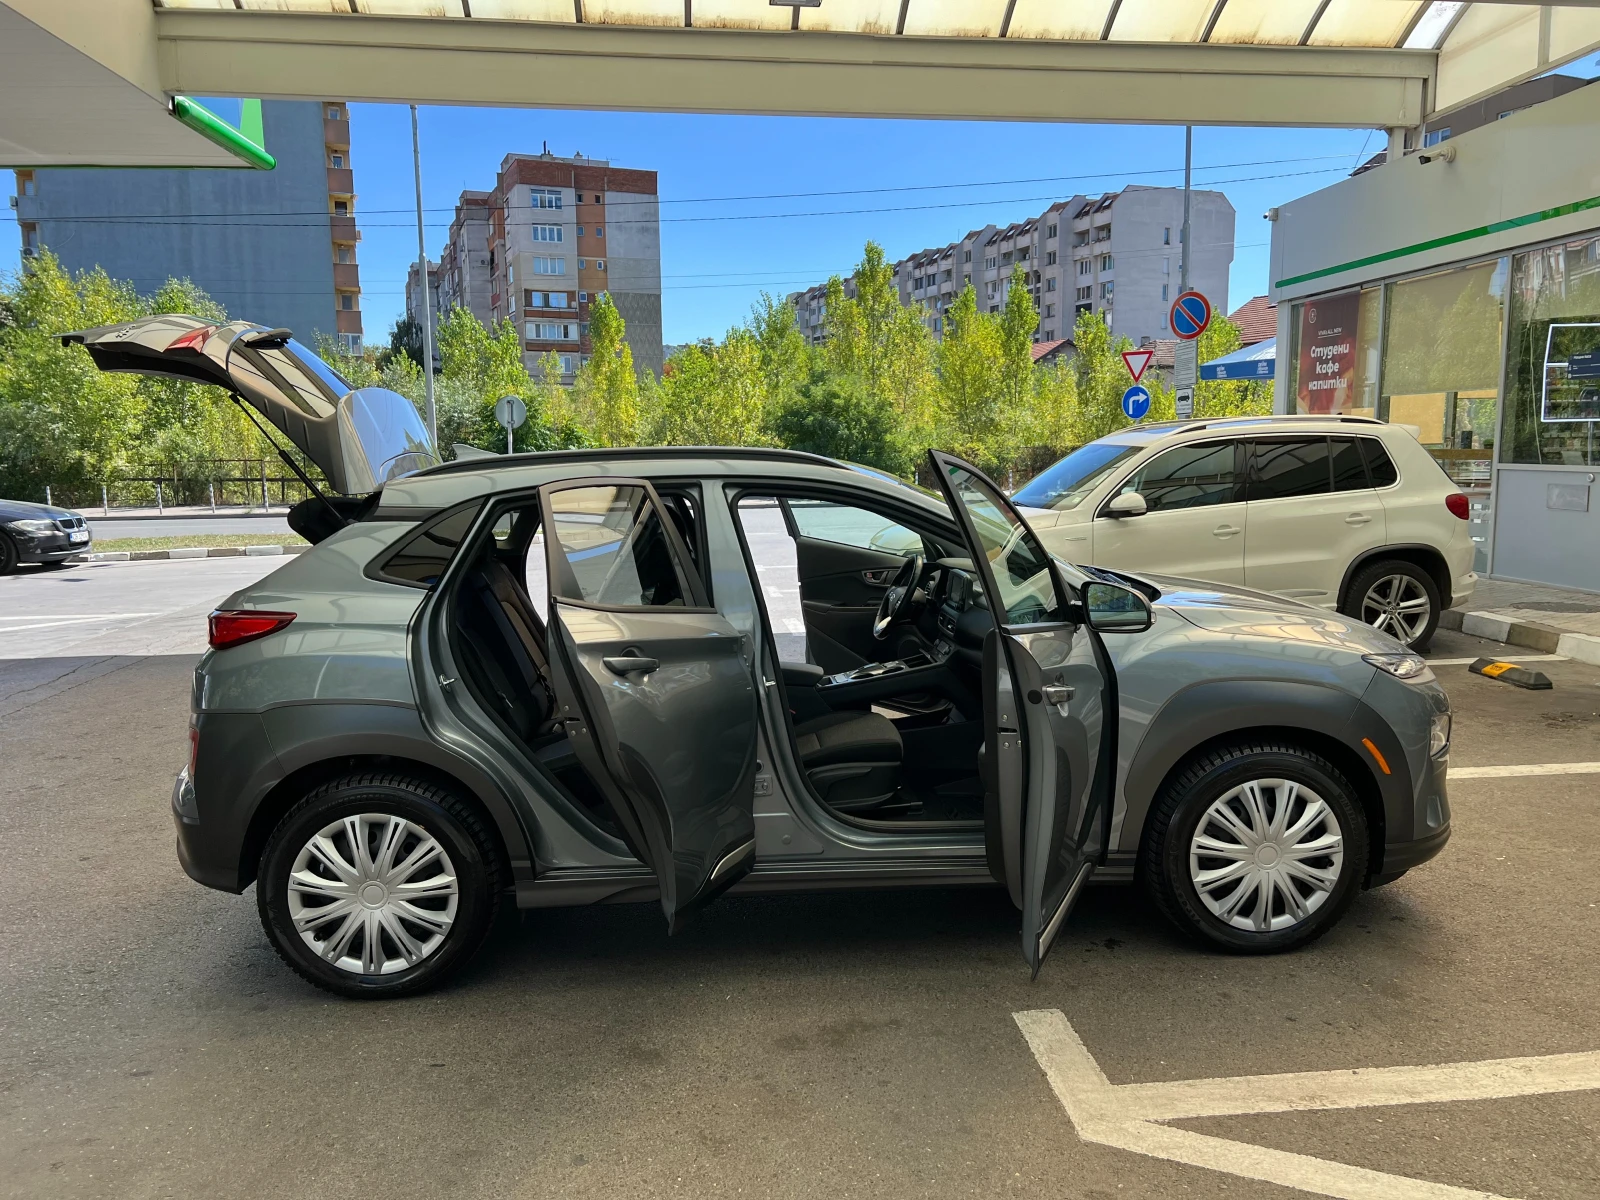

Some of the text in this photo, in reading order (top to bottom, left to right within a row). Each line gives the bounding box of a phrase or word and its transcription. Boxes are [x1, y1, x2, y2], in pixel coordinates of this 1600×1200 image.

[1310, 343, 1349, 359] Студени
[1316, 360, 1340, 376] кафе
[1308, 376, 1347, 390] напитки
